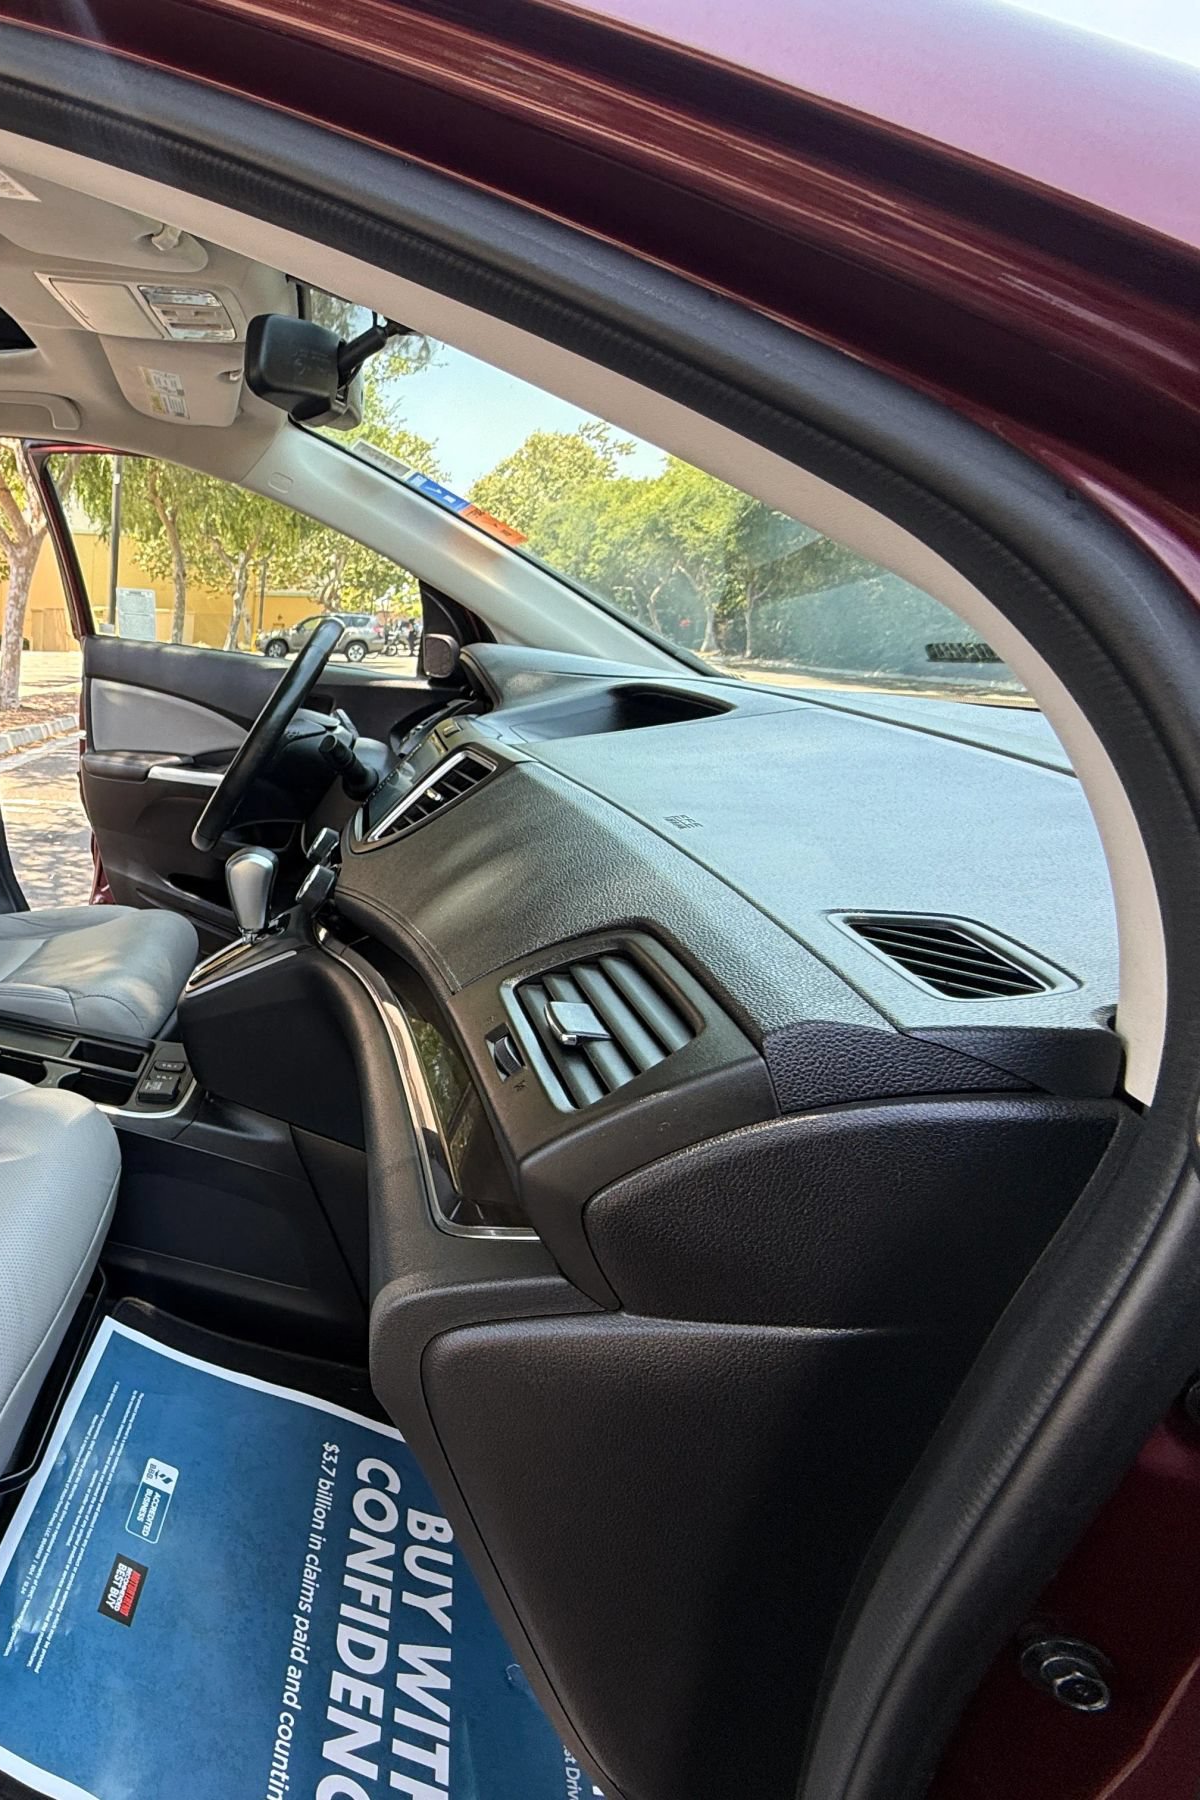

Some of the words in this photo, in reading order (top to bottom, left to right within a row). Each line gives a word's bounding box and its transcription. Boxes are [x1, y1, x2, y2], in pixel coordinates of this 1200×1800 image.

[322, 1441, 340, 1478] $3.7
[136, 1488, 150, 1522] BUSINESS
[142, 1492, 161, 1537] ACCREDITED
[312, 1478, 335, 1531] billion
[308, 1530, 326, 1551] in
[113, 1562, 127, 1587] BEST
[299, 1553, 322, 1612] claims
[401, 1508, 454, 1634] BUY
[106, 1589, 120, 1612] BUY
[289, 1614, 311, 1664] paid
[281, 1665, 302, 1709] and
[563, 1745, 577, 1764] st
